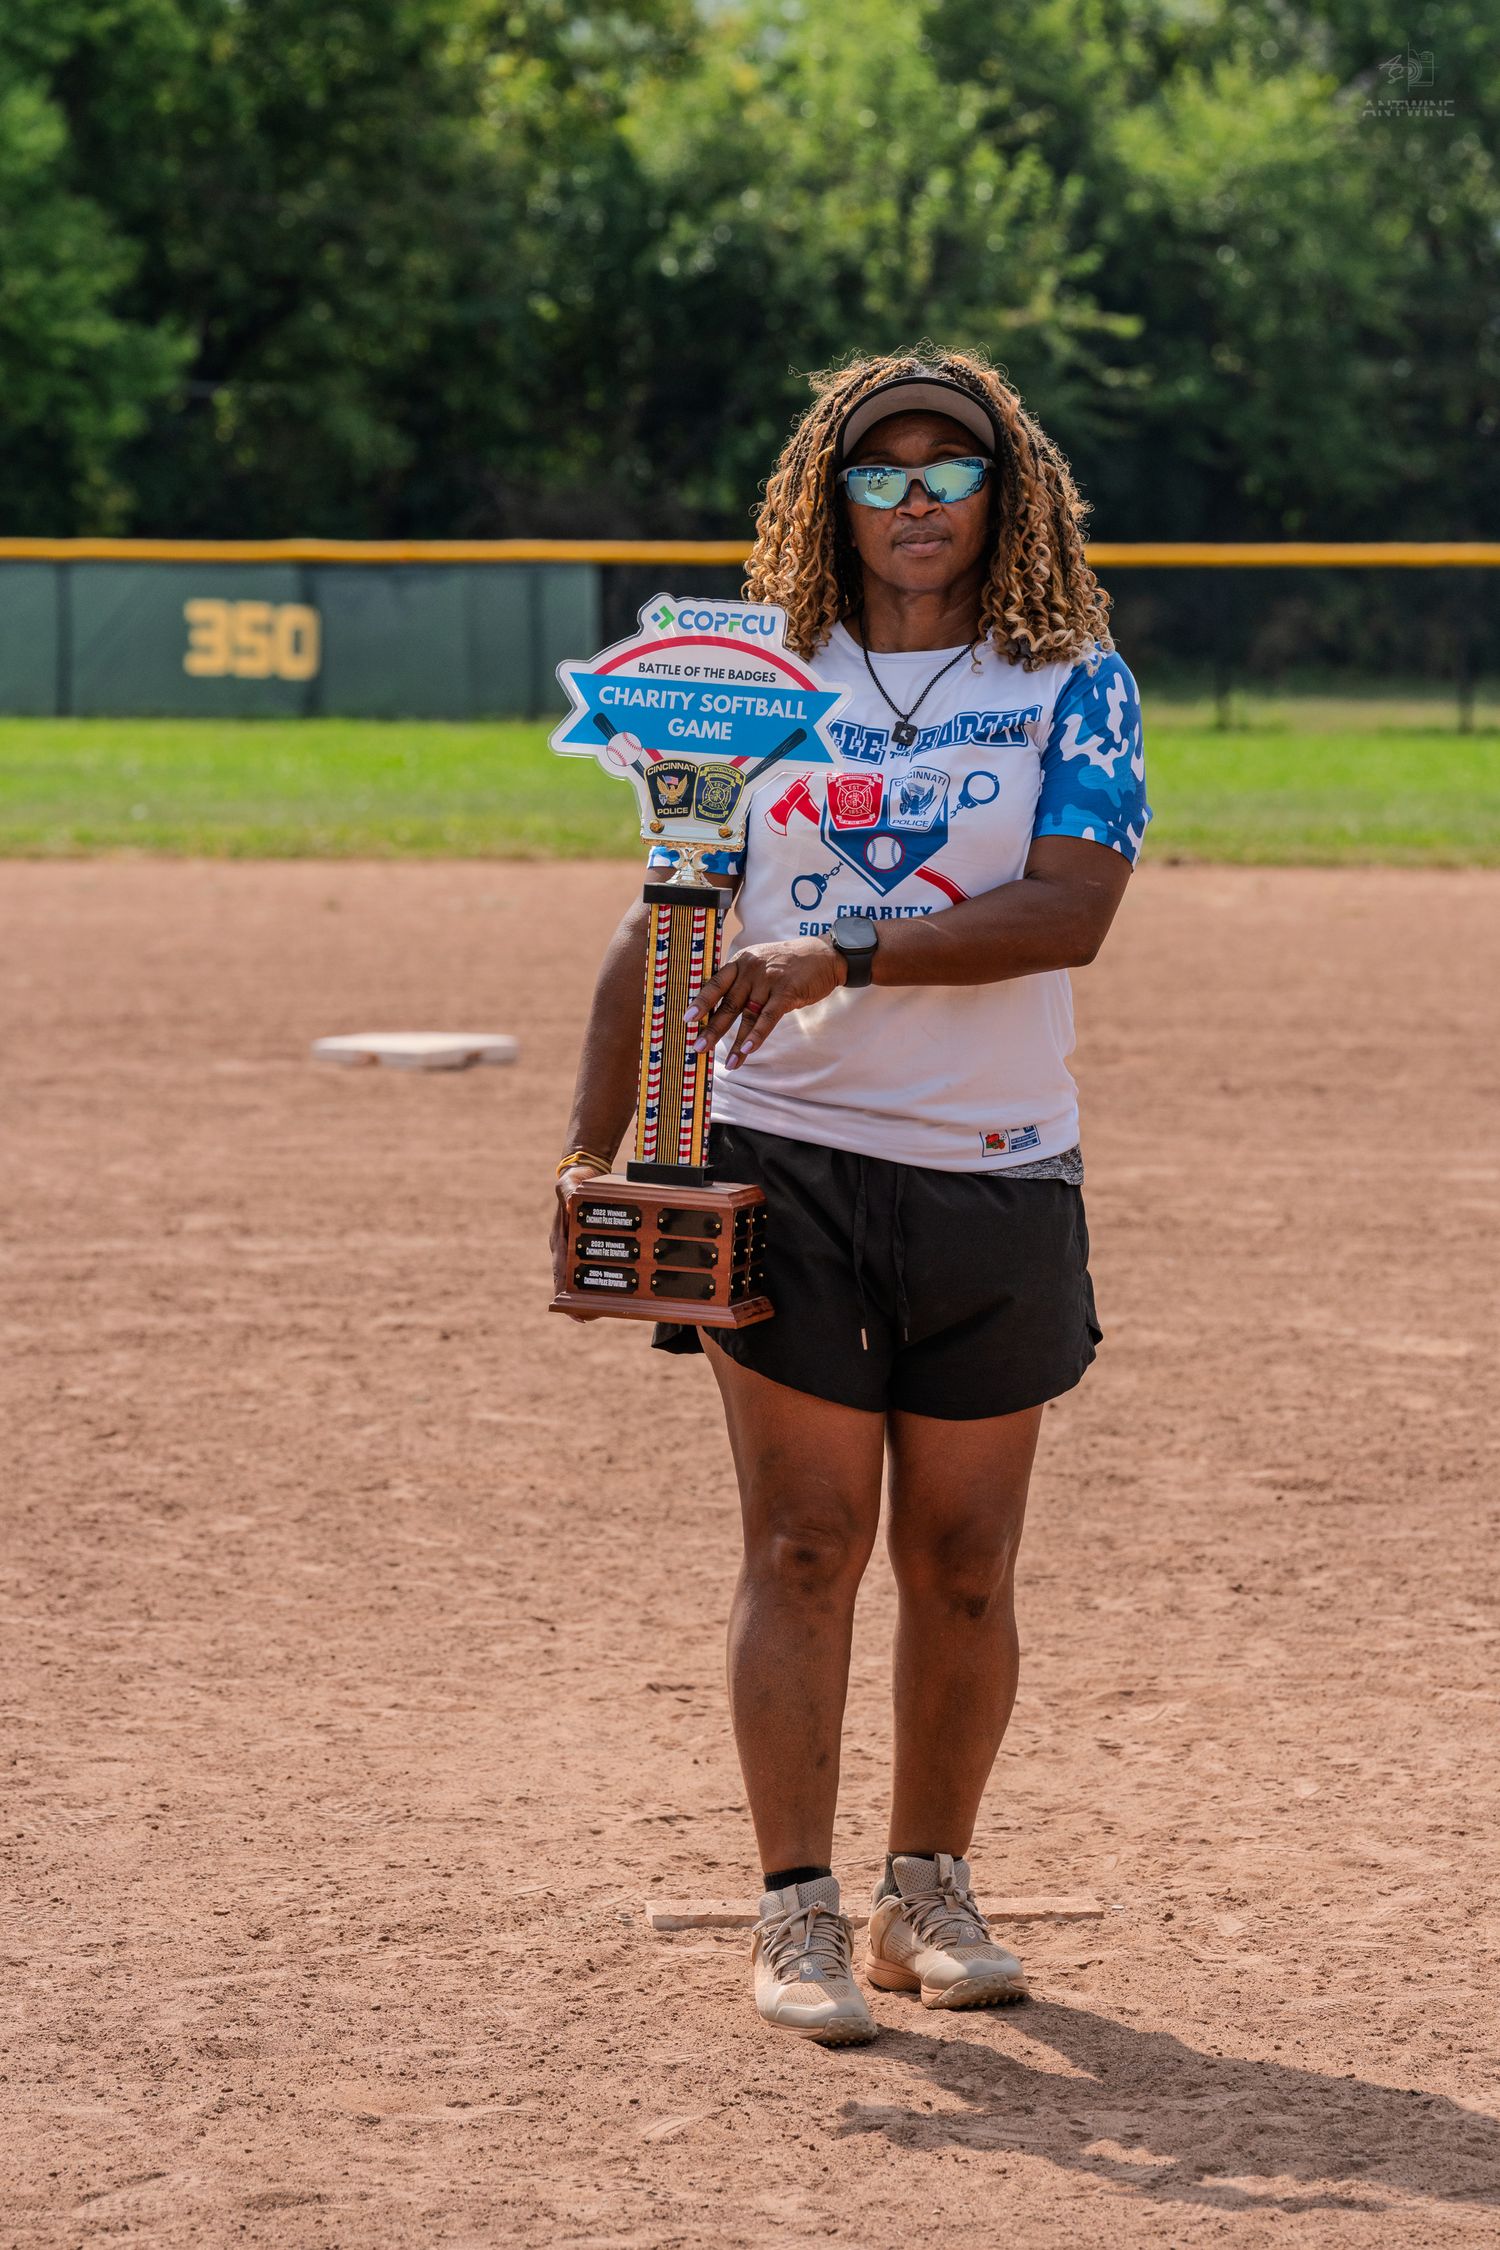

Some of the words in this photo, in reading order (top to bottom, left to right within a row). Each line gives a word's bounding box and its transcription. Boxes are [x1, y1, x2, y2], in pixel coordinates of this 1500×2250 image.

[677, 609, 776, 636] COPFCU
[183, 598, 322, 682] 350
[638, 662, 681, 677] BATTLE
[684, 666, 701, 677] OF
[703, 667, 726, 680] THE
[728, 670, 777, 683] BADGES
[598, 685, 696, 711] CHARITY
[699, 693, 808, 720] SOFTBALL
[668, 718, 733, 741] GAME
[647, 761, 698, 777] CINCINNATI
[657, 806, 690, 816] POLICE
[891, 819, 930, 828] POLICE
[836, 904, 933, 921] CHARITY
[592, 1208, 607, 1216] 2022
[590, 1240, 605, 1248] 2023
